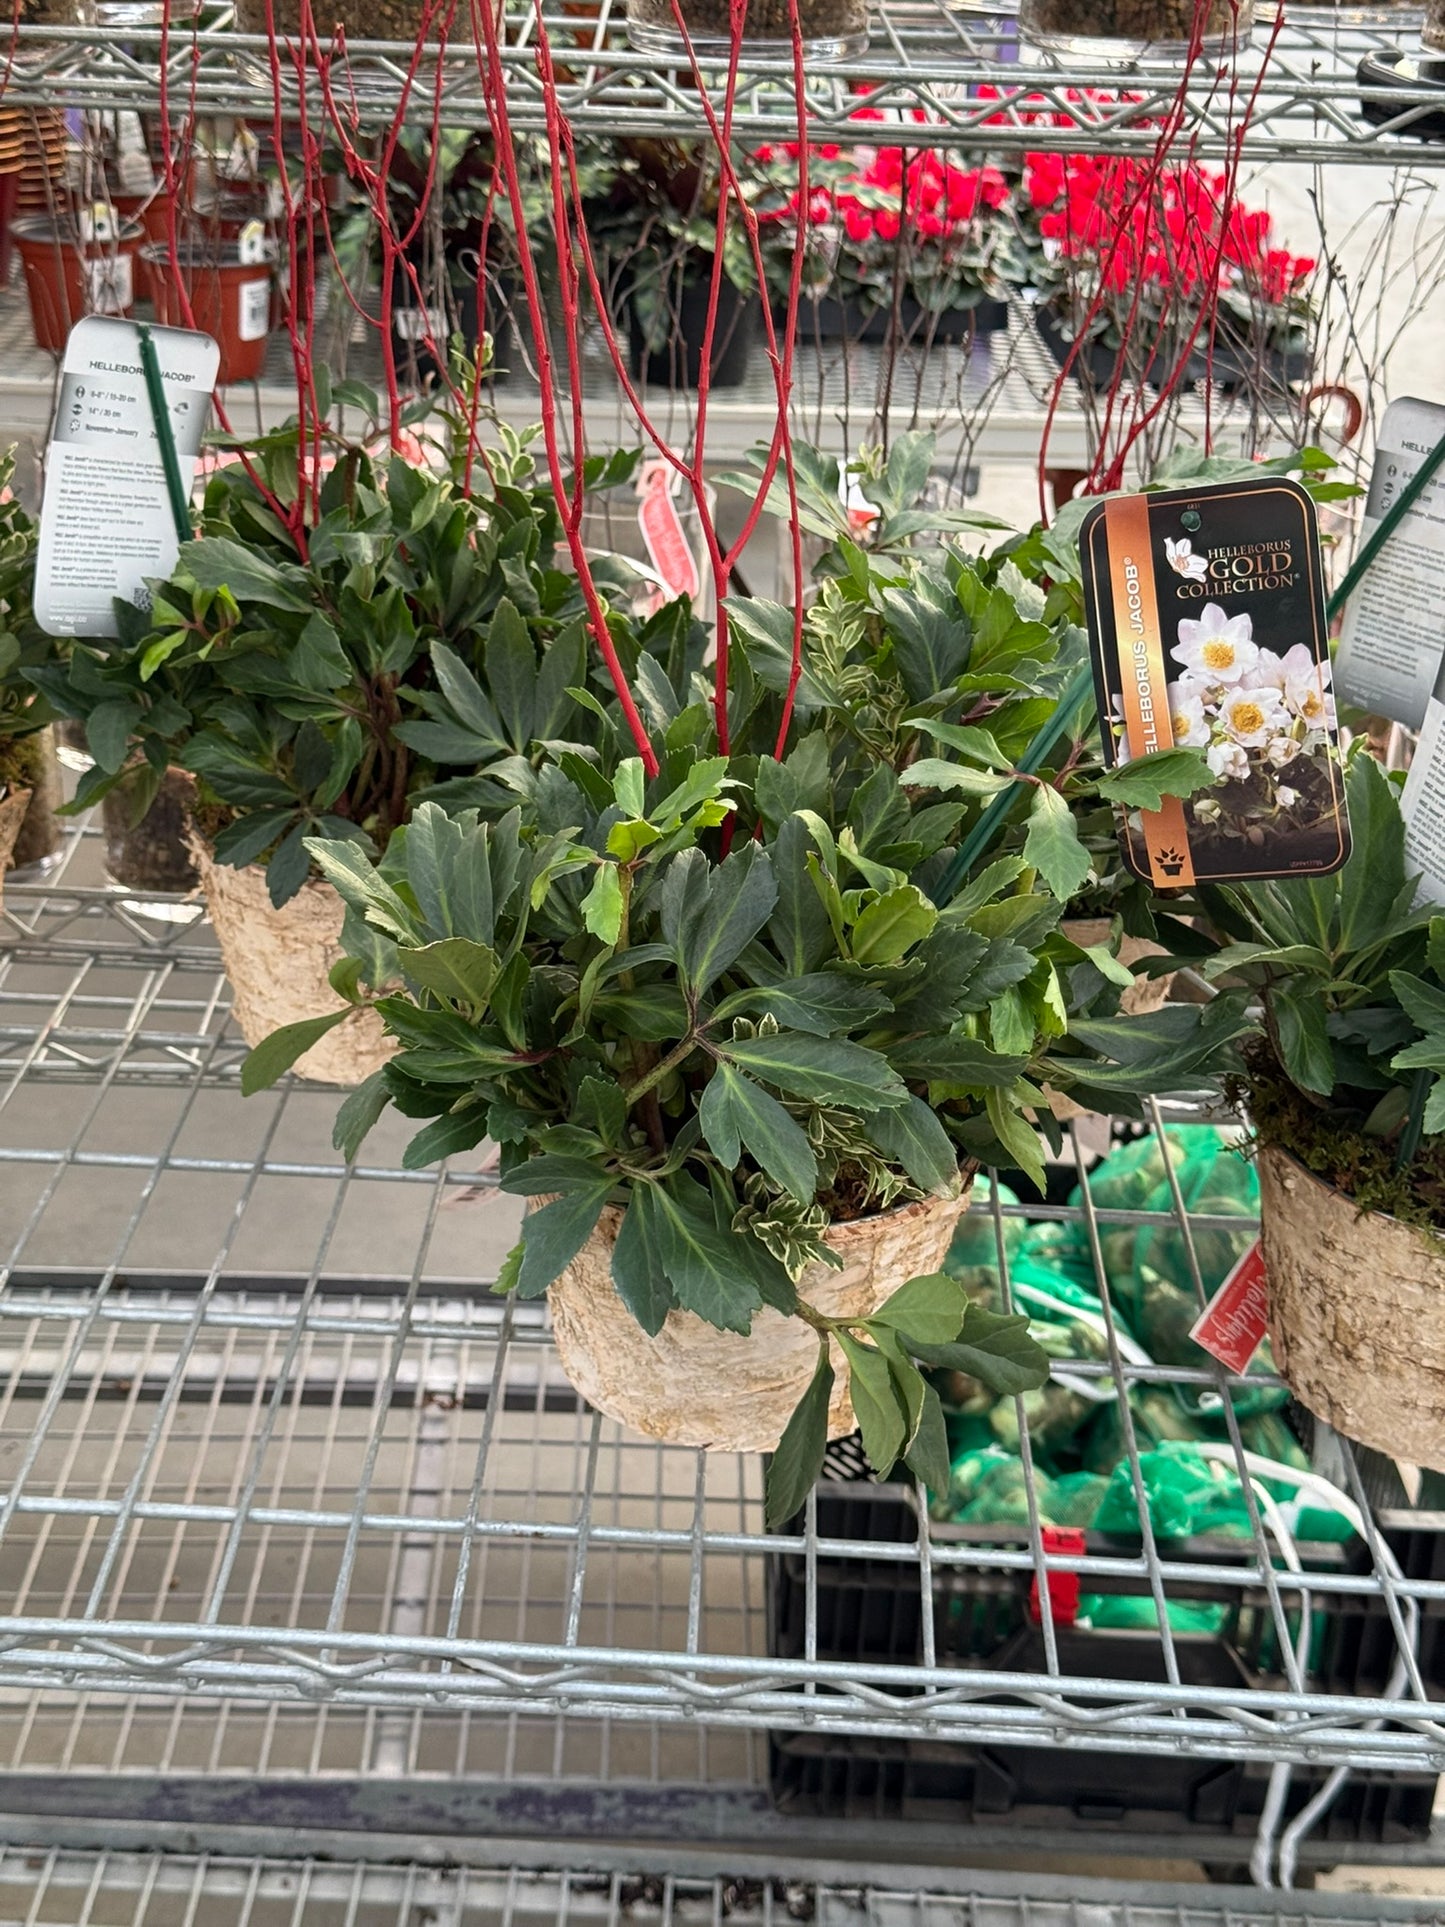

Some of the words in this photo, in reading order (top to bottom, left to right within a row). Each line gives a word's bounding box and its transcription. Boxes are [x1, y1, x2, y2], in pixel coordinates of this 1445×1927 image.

[89, 361, 146, 376] HELLEBOR
[1208, 539, 1291, 559] HELLEBORUS
[1209, 552, 1292, 579] GOLD
[1133, 640, 1159, 755] ELLEBORUS
